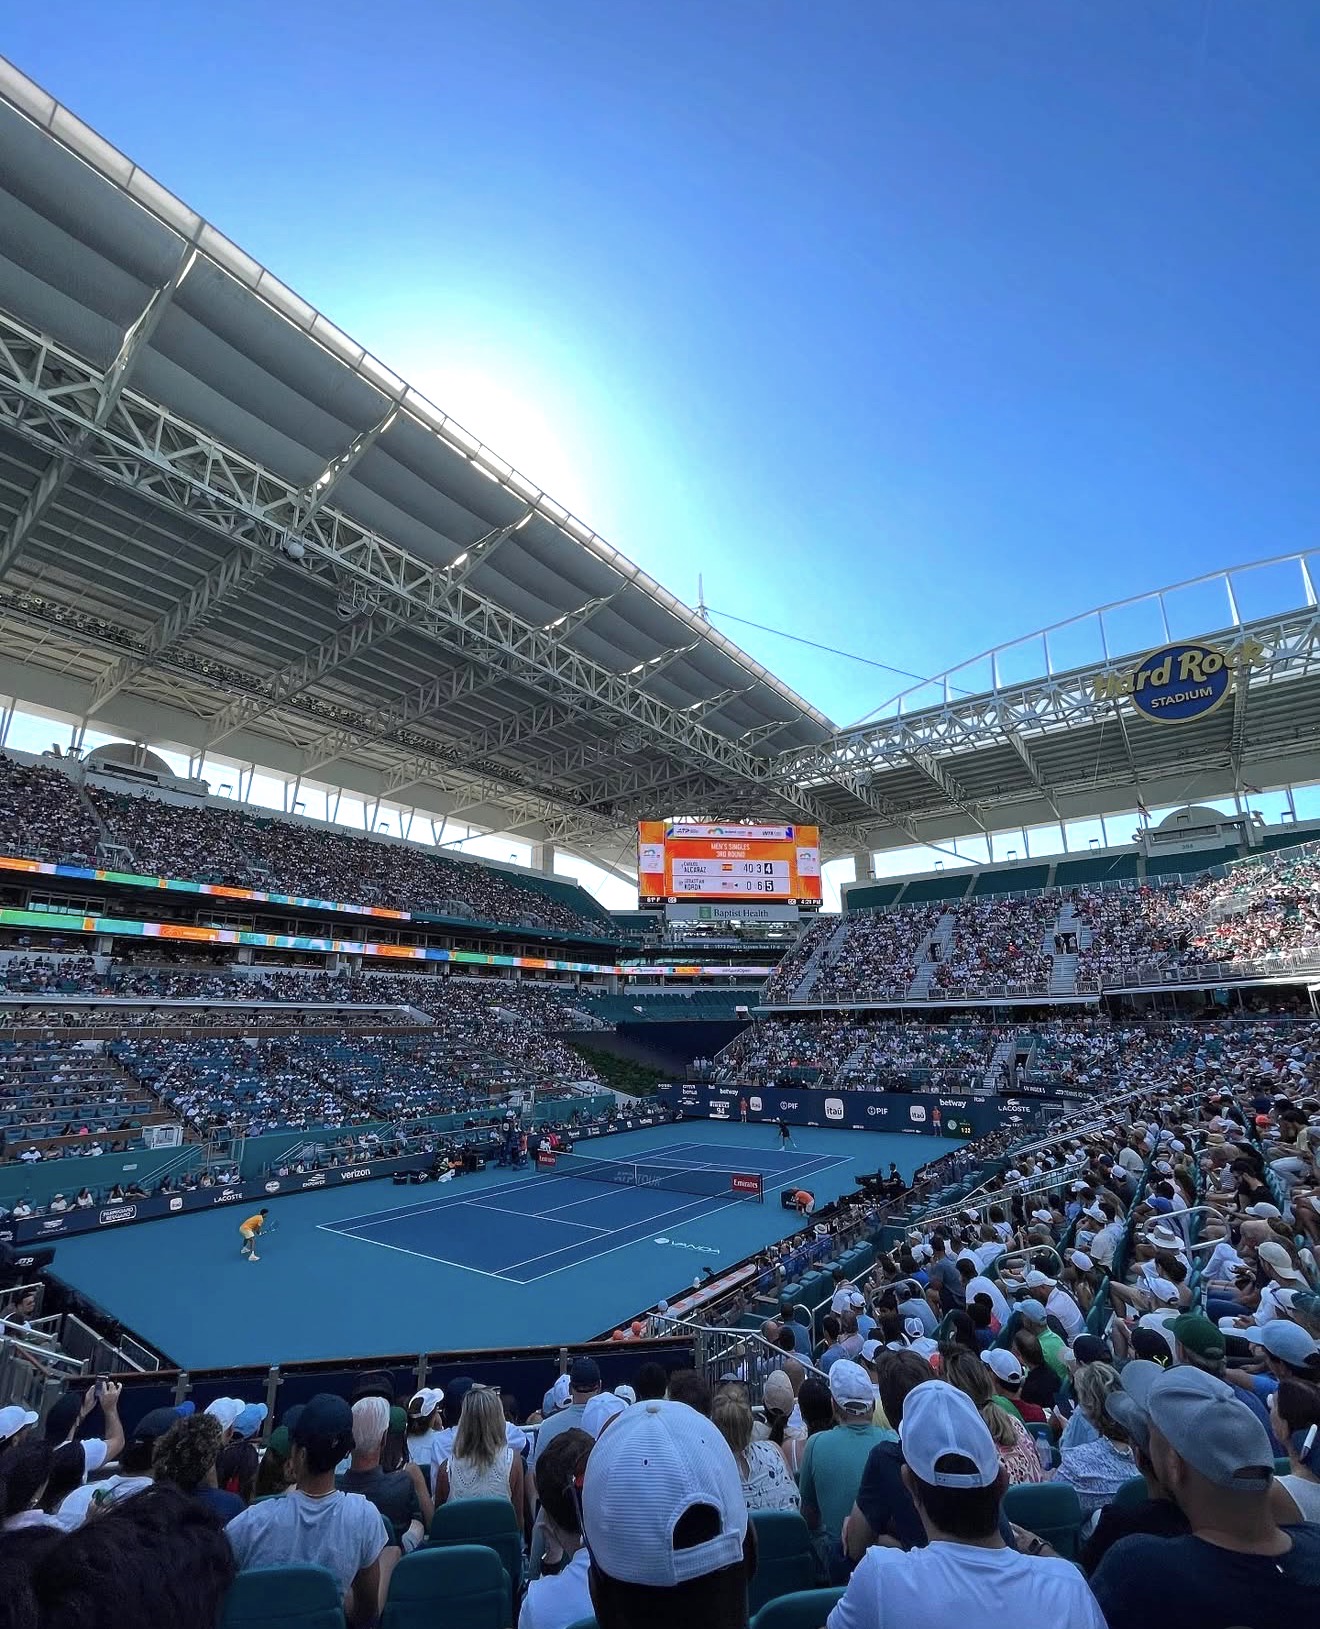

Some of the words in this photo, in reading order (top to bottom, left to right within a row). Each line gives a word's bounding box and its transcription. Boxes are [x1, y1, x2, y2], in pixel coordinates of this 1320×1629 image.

[1093, 656, 1172, 699] Hard
[1178, 638, 1265, 682] Rock
[1151, 686, 1213, 708] STADIUM
[729, 843, 750, 851] SINGLES
[756, 863, 762, 873] 3
[765, 863, 771, 874] 4
[746, 881, 752, 891] 0
[757, 881, 763, 891] 6
[766, 881, 772, 891] 5
[714, 908, 741, 918] Baptist
[743, 908, 769, 917] Health
[719, 1088, 739, 1096] betway
[787, 1102, 799, 1110] PIF
[939, 1098, 967, 1108] betway
[826, 1106, 842, 1116] itaú
[876, 1107, 888, 1115] PIF
[997, 1105, 1031, 1113] LACOSTE
[911, 1111, 925, 1119] itaú
[341, 1168, 371, 1180] verizon
[733, 1178, 759, 1189] Emirates
[213, 1193, 243, 1203] LACOSTE
[105, 1212, 131, 1221] REGGIANO
